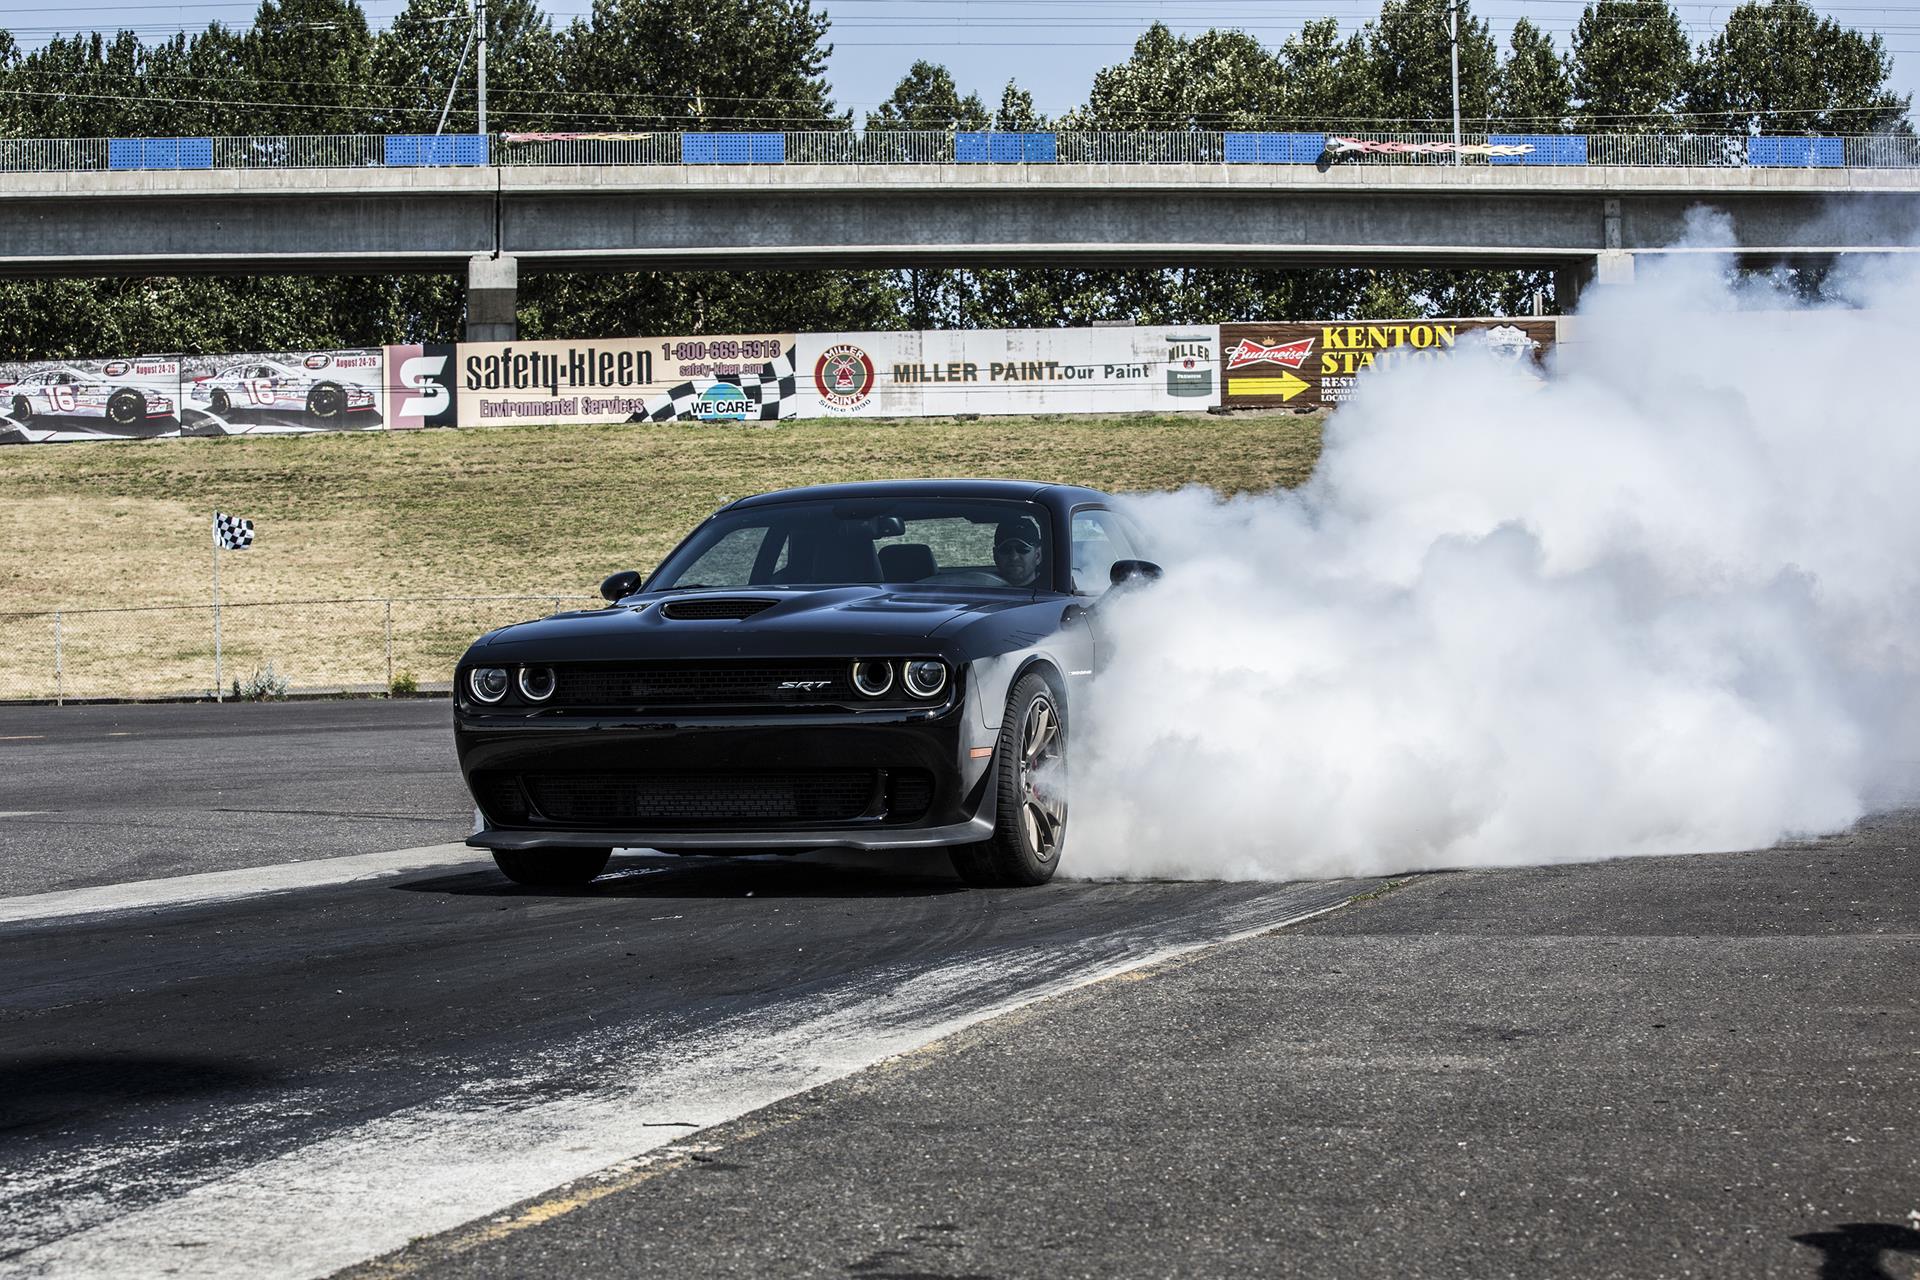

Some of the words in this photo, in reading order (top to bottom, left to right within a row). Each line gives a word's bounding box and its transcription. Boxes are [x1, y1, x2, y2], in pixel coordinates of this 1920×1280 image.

[1321, 325, 1457, 349] KENTON
[661, 340, 781, 361] 1-800-669-5913
[824, 345, 865, 360] MILLER
[1168, 344, 1210, 363] MILLER
[1224, 346, 1313, 362] Budweiser
[136, 364, 157, 375] August
[158, 363, 176, 374] 24-26
[336, 358, 357, 369] August
[359, 357, 377, 367] 24-26
[679, 362, 764, 377] safety-kleen.com
[893, 363, 978, 384] MILLER
[1104, 364, 1150, 379] Paint
[44, 386, 77, 412] 16
[243, 379, 276, 406] 16
[826, 392, 865, 407] PAINTS
[480, 397, 578, 418] Environmental
[582, 396, 644, 416] Services
[691, 402, 713, 414] WE
[716, 400, 757, 413] CARE.
[818, 398, 846, 413] Since
[777, 680, 832, 692] SRT
